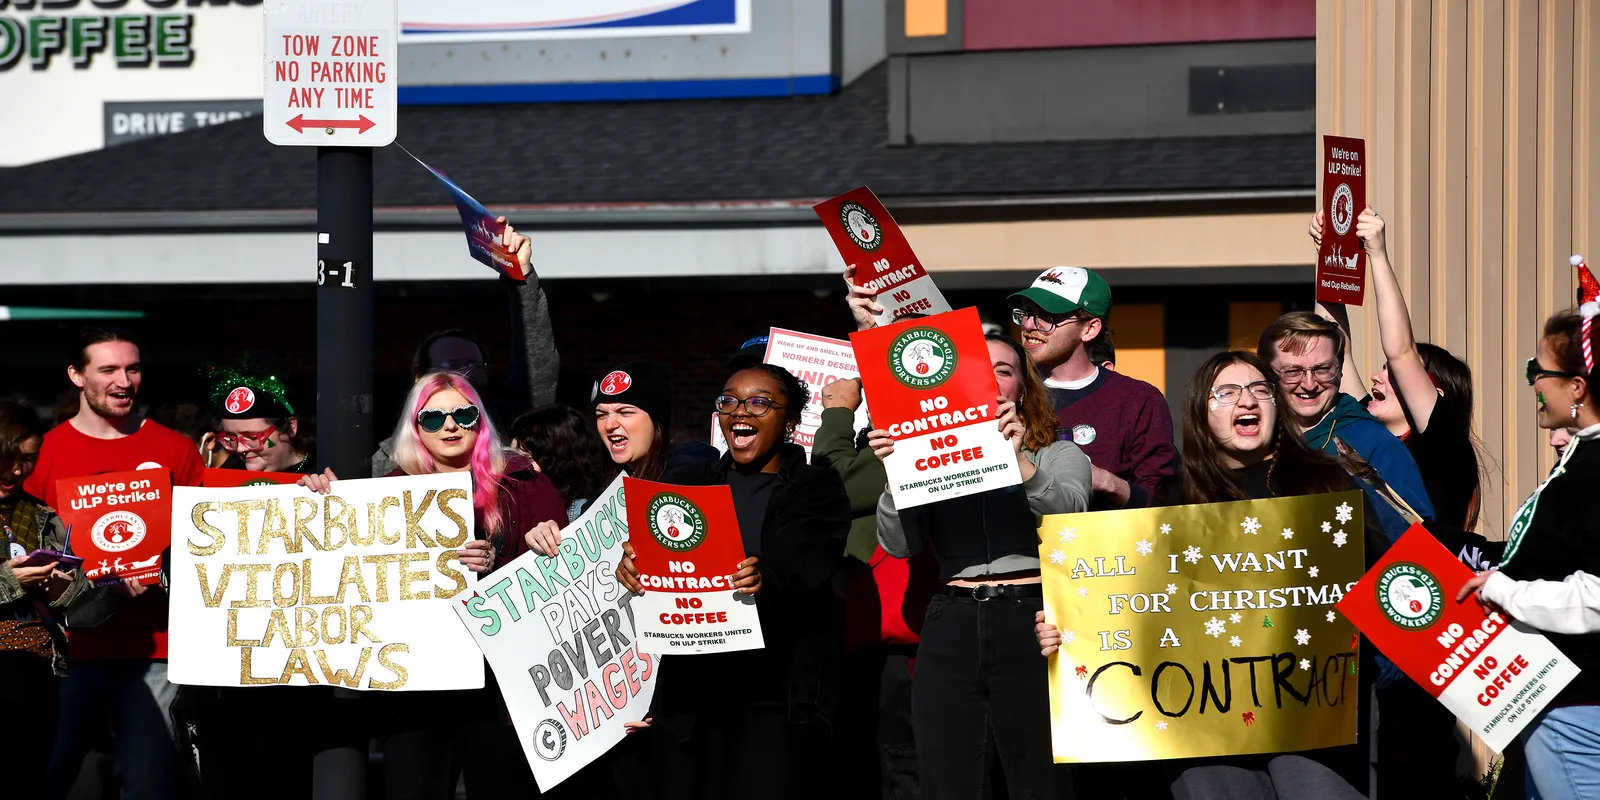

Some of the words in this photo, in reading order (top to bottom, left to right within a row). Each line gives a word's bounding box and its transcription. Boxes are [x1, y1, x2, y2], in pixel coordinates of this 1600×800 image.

[283, 34, 320, 56] TOW
[331, 35, 379, 57] ZONE
[275, 61, 299, 83] NO
[310, 61, 386, 84] PARKING
[287, 87, 325, 109] ANY
[334, 87, 375, 109] TIME
[112, 112, 184, 135] DRIVE
[1331, 147, 1349, 160] We're
[1350, 151, 1359, 161] on
[1328, 162, 1341, 174] ULP
[1341, 163, 1362, 177] Strike!
[841, 203, 867, 222] STARBUCKS
[846, 226, 874, 250] WORKERS
[870, 217, 881, 245] UNITED
[873, 258, 890, 273] NO
[863, 264, 917, 291] CONTRACT
[1321, 279, 1331, 288] Red
[1331, 280, 1340, 291] Cup
[1340, 281, 1361, 292] Rebellion
[892, 289, 911, 303] NO
[893, 298, 932, 319] COFFEE
[777, 340, 795, 349] WAKE
[820, 348, 839, 357] SMELL
[840, 351, 853, 359] THE
[894, 330, 946, 353] STARBUCKS
[782, 351, 825, 366] WORKERS
[827, 360, 860, 372] DESER
[893, 358, 930, 386] WORKERS
[935, 348, 953, 381] UNITED
[790, 369, 838, 387] UNIO
[919, 396, 948, 413] NO
[888, 404, 989, 437] CONTRACT
[796, 433, 814, 444] AN
[930, 434, 958, 451] NO
[915, 446, 984, 471] COFFEE
[78, 482, 126, 496] We're
[129, 479, 151, 490] on
[899, 477, 943, 491] STARBUCKS
[943, 469, 980, 482] WORKERS
[981, 463, 1009, 474] UNITED
[928, 486, 940, 494] ON
[941, 482, 955, 491] ULP
[956, 477, 984, 488] STRIKE!
[71, 496, 103, 510] ULP
[106, 489, 160, 506] Strike!
[652, 496, 697, 514] STARBUCKS
[187, 488, 469, 557] STARBUCKS
[650, 515, 679, 549] WORKERS
[684, 519, 703, 548] UNITED
[668, 560, 696, 574] NO
[1071, 555, 1136, 579] ALL
[1167, 554, 1179, 574] I
[1210, 549, 1308, 574] WANT
[194, 549, 469, 609] VIOLATES
[639, 574, 734, 590] CONTRACT
[1379, 565, 1416, 603] STARBUCKS
[540, 560, 620, 645] PAYS
[675, 597, 703, 609] NO
[1108, 592, 1172, 615] FOR
[1420, 574, 1441, 611] UNITED
[226, 604, 383, 648] LABOR
[659, 611, 728, 625] COFFEE
[1386, 607, 1433, 627] WORKERS
[643, 631, 685, 639] STARBUCKS
[685, 631, 723, 639] WORKERS
[724, 628, 752, 636] UNITED
[698, 638, 726, 646] STRIKE!
[1098, 629, 1132, 651] IS
[1159, 627, 1181, 649] A
[1437, 623, 1464, 649] NO
[528, 590, 638, 708] POVERT
[1429, 611, 1504, 687] CONTRACT
[239, 642, 410, 690] LAWS
[1473, 655, 1498, 680] NO
[556, 640, 654, 742] WAGES
[1085, 652, 1356, 726] CONTRACT
[1477, 654, 1529, 707] COFFEE
[1483, 702, 1514, 734] STARBUCKS
[1510, 677, 1539, 705] WORKERS
[1536, 658, 1559, 680] UNITED
[1507, 713, 1518, 723] ON
[1515, 703, 1527, 716] ULP
[1526, 683, 1547, 705] STRIKE!
